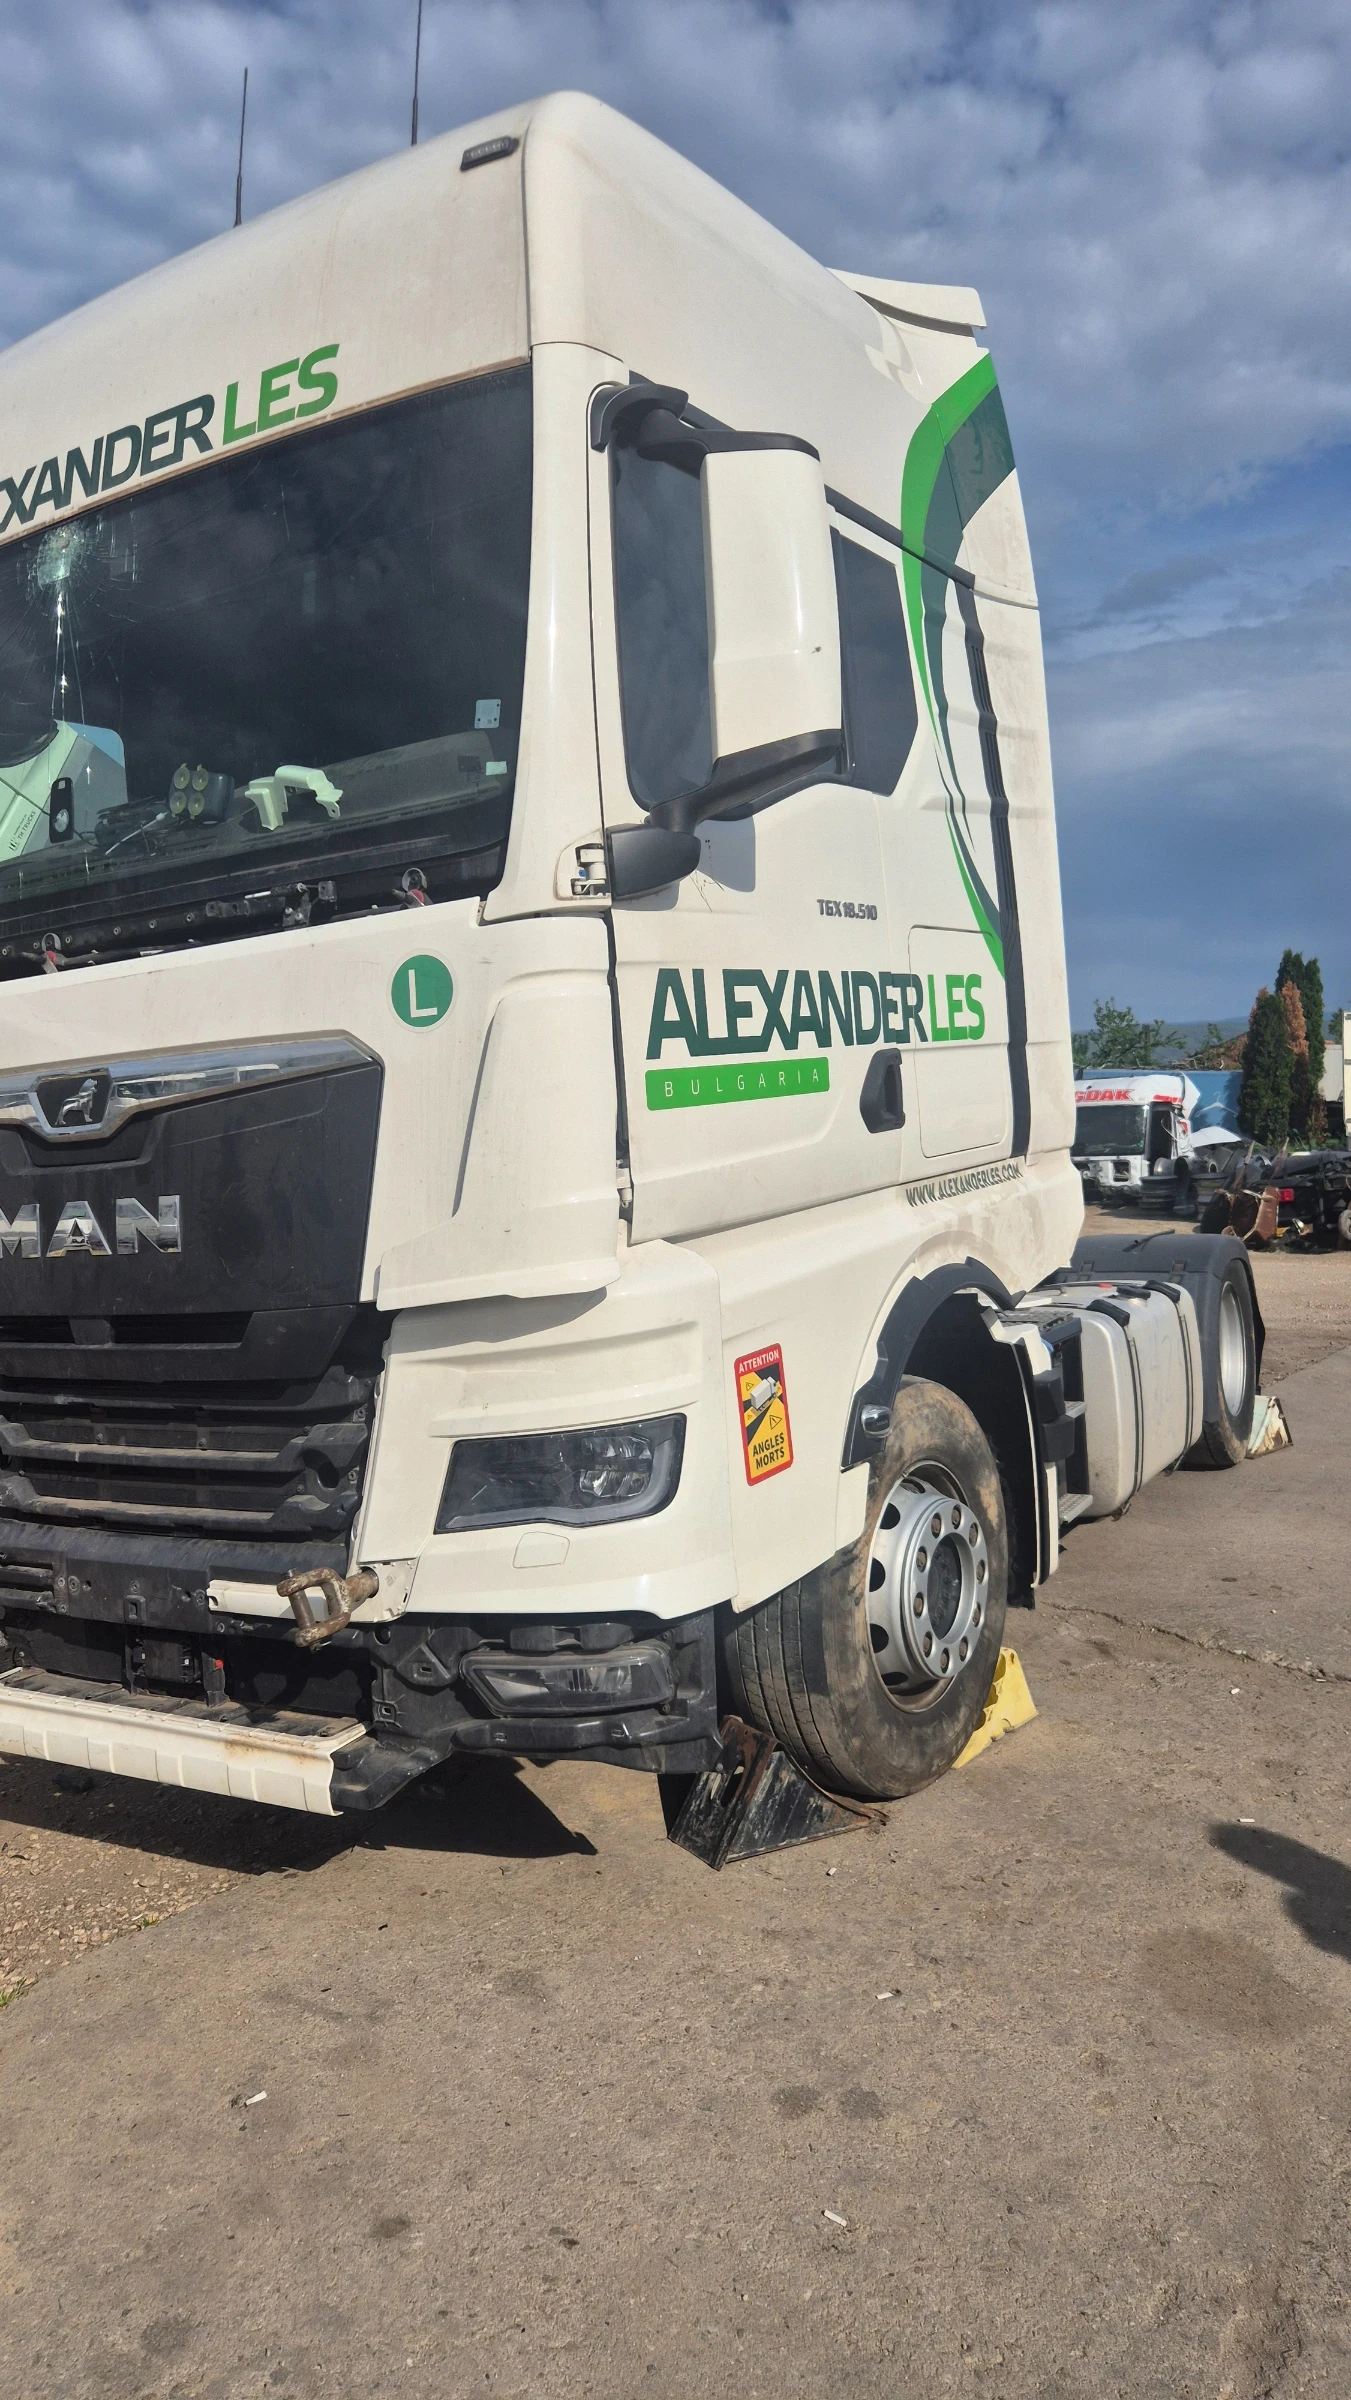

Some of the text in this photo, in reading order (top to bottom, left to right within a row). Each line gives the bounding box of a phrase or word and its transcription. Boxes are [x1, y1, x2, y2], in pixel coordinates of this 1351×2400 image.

[408, 969, 438, 1018] L
[665, 1069, 819, 1097] BULGARIA
[905, 1162, 1024, 1207] WWW.ALEXANDERLES.COM
[0, 1195, 182, 1258] MAN
[739, 1349, 779, 1374] ATTENTION
[753, 1432, 784, 1457] ANGLES
[755, 1447, 785, 1470] MORTS
